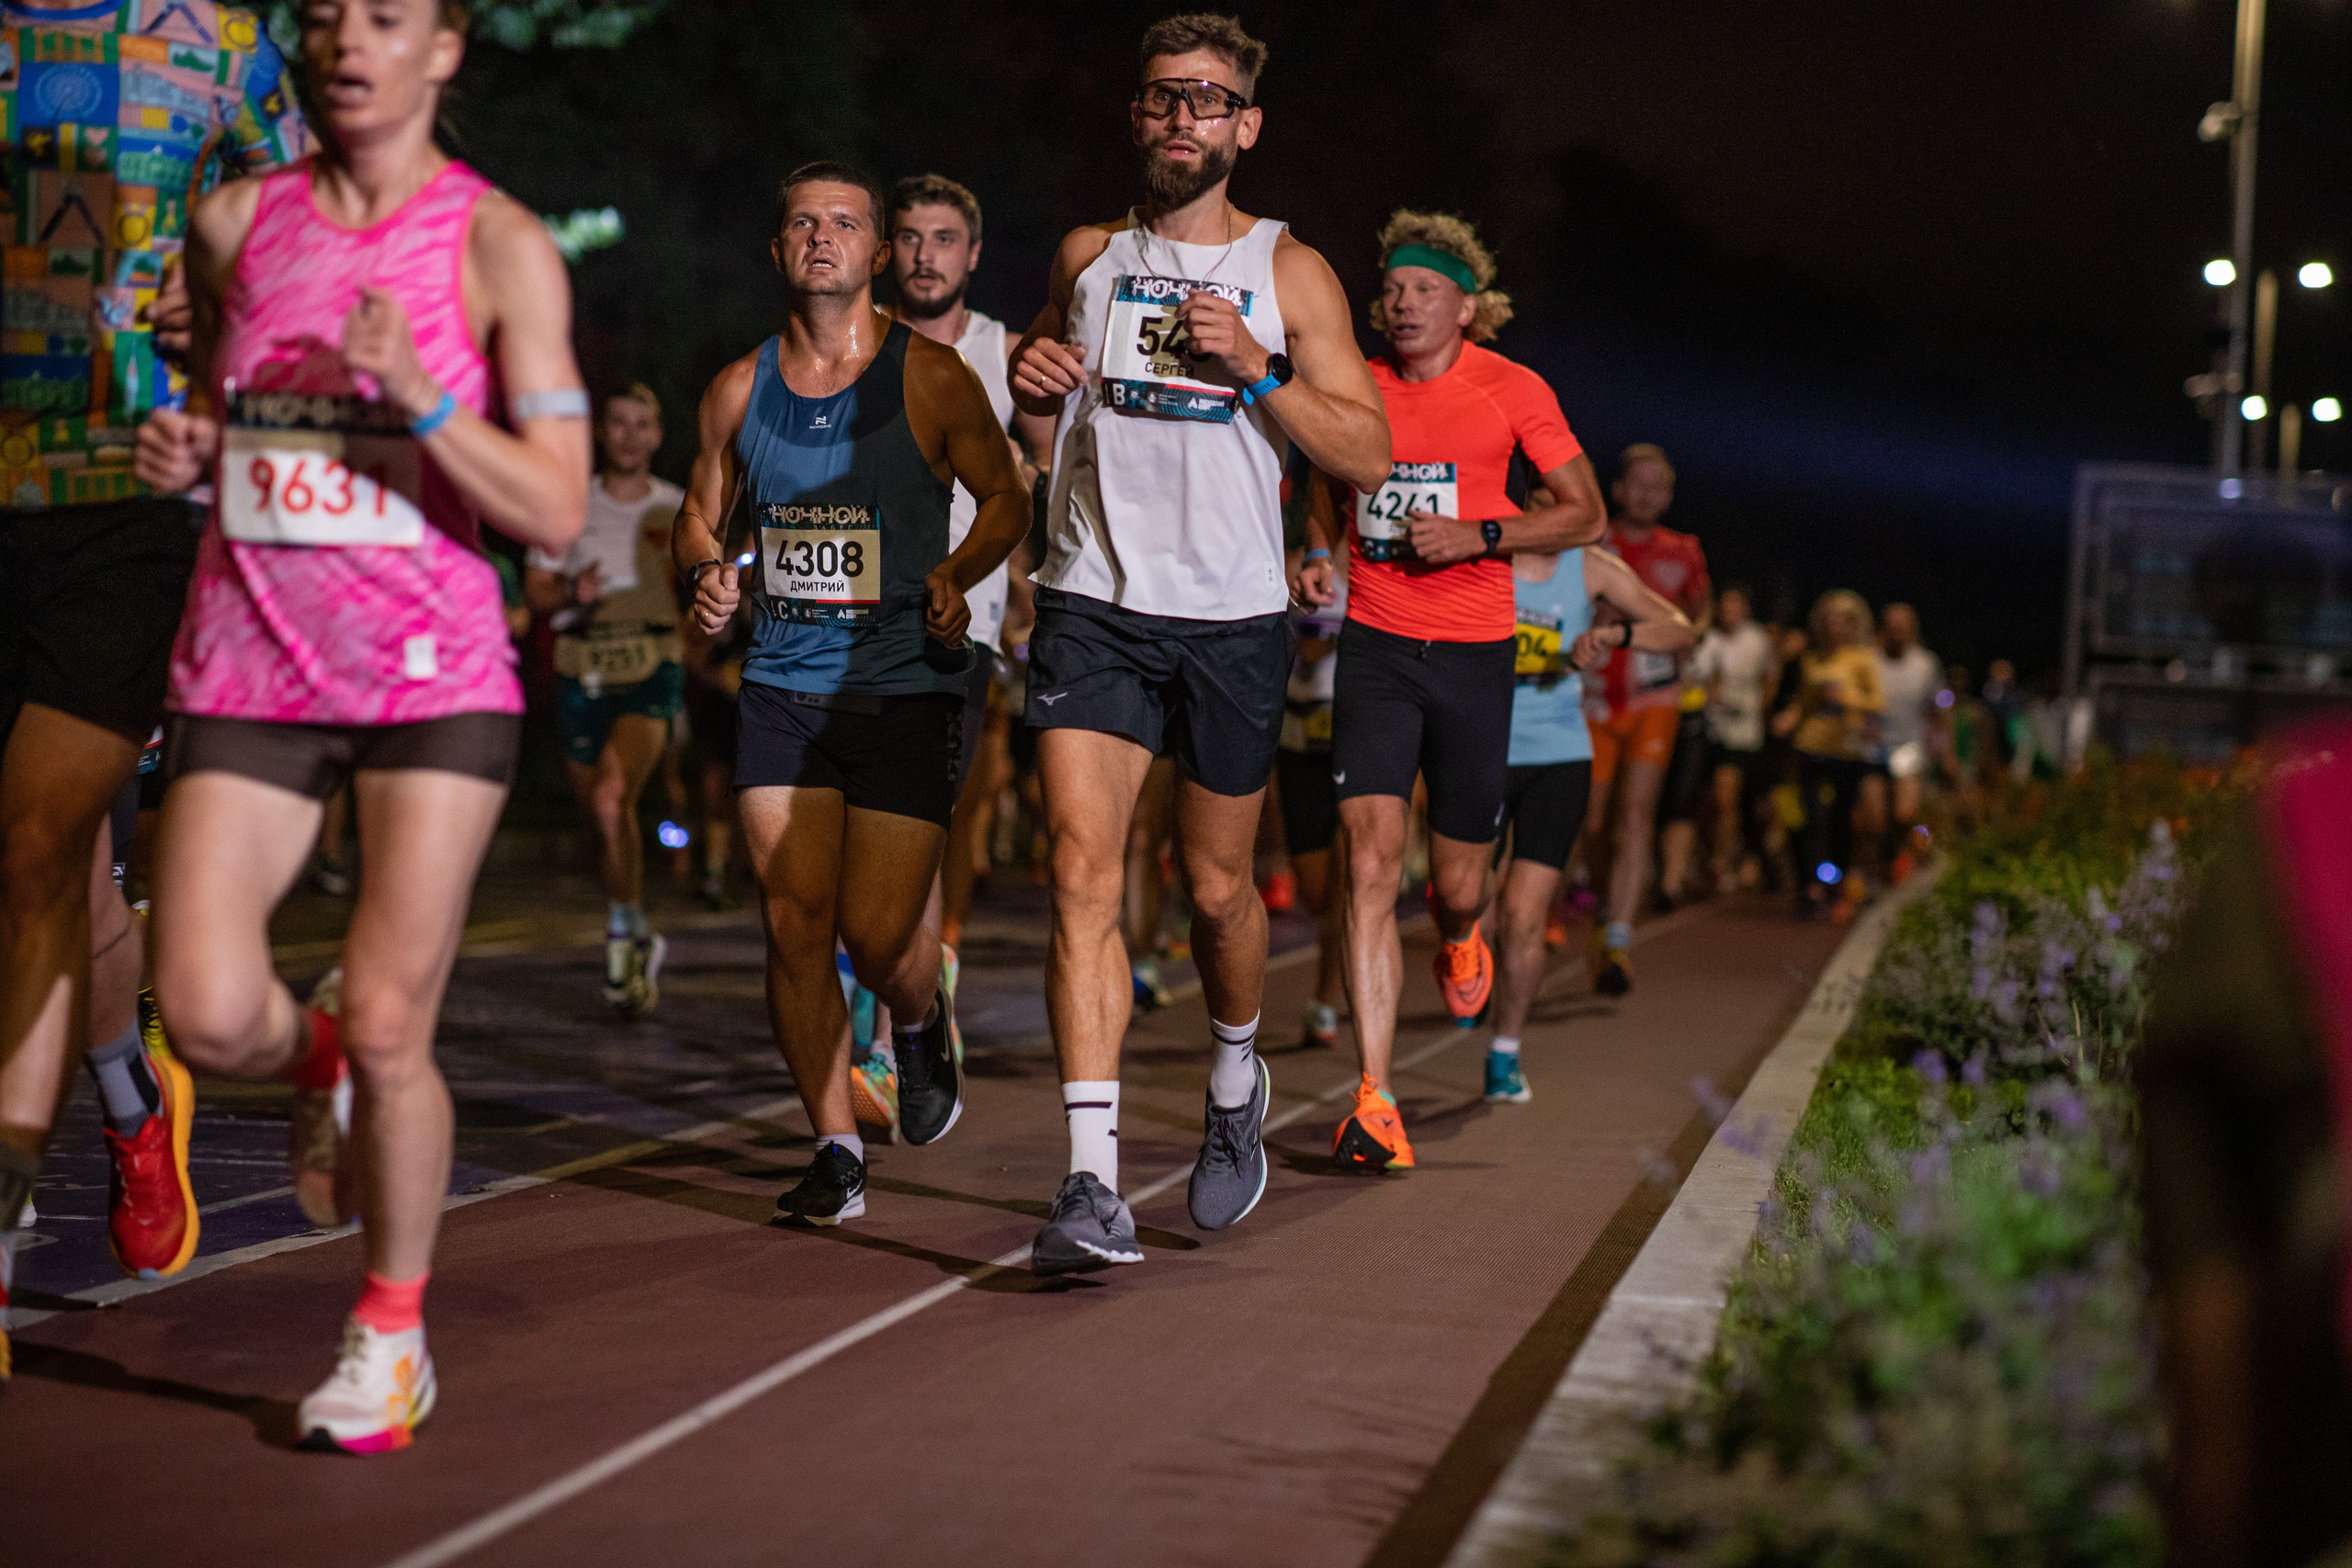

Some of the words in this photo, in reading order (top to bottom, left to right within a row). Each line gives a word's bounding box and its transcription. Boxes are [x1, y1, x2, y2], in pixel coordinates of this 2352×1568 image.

[1132, 276, 1243, 307] НОЧОЙ
[1136, 316, 1211, 362] 54
[1145, 361, 1194, 378] СЕРГЕЙ
[1113, 383, 1125, 406] B
[1392, 462, 1448, 479] ЧНОЙ
[250, 457, 386, 519] 9631
[770, 503, 870, 525] НОЧНОЙ
[775, 540, 864, 578] 4308
[790, 580, 844, 592] ДМИТРИЙ
